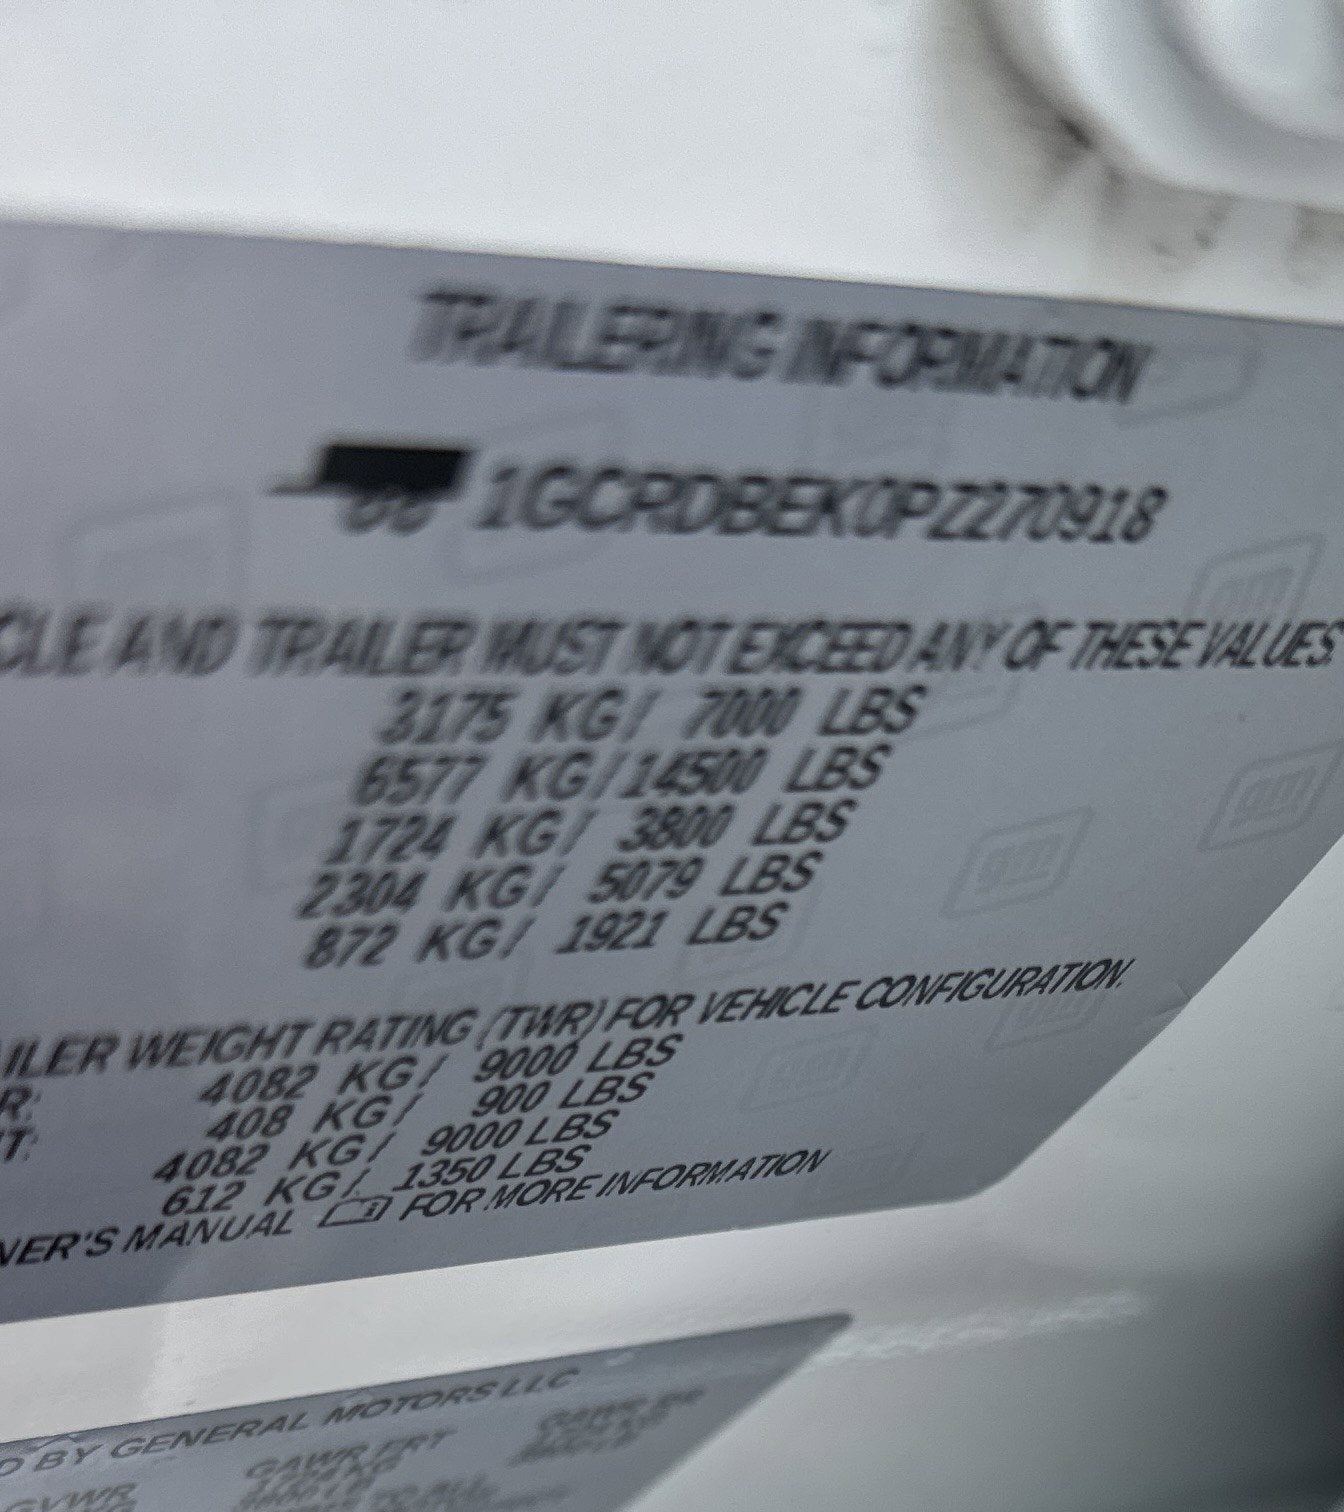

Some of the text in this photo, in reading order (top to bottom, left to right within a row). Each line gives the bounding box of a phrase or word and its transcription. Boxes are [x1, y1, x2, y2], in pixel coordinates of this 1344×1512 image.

[411, 290, 1150, 404] TRAILERING INFORMATION
[98, 612, 246, 676] AND
[254, 614, 472, 678] TRAILER
[476, 617, 630, 676] MUST
[628, 617, 734, 676] NOT
[728, 617, 912, 676] EXCEED
[908, 619, 1010, 674] ANY
[998, 618, 1076, 670] OF
[1068, 618, 1208, 670] THESE
[376, 688, 518, 744] 3175
[682, 684, 806, 740] 7000
[816, 682, 928, 738] LBS
[352, 752, 490, 804] 6577
[780, 740, 896, 796] LBS
[320, 814, 458, 868] 1724
[614, 801, 738, 854] 3800
[748, 797, 858, 850] LBS
[298, 868, 428, 922] 2304
[586, 856, 706, 906] 5079
[716, 850, 826, 900] LBS
[302, 920, 400, 970] 872
[554, 908, 672, 956] 1921
[684, 900, 790, 946] LBS
[122, 1018, 320, 1072] WEIGHT
[312, 1006, 482, 1058] RATING
[476, 998, 606, 1054] (TWR)
[598, 992, 698, 1036] FOR
[692, 980, 860, 1028] VEHICLE
[856, 957, 1136, 1012] CONFIGURATION.
[194, 1064, 322, 1108] 4082
[472, 1040, 580, 1084] 9000
[586, 1032, 684, 1076] LBS
[202, 1104, 298, 1144] 408
[470, 1078, 556, 1120] 900
[558, 1071, 656, 1112] LBS
[150, 1142, 274, 1186] 4082
[420, 1116, 524, 1160] 9000
[524, 1108, 622, 1150] LBS
[160, 1182, 248, 1218] 612
[392, 1152, 500, 1194] 1350
[496, 1143, 594, 1182] LBS
[120, 1208, 298, 1254] MANUAL
[398, 1184, 492, 1222] FOR
[484, 1174, 604, 1212] MORE
[596, 1149, 834, 1197] INFORMATION
[33, 1444, 103, 1473] BY
[109, 1415, 310, 1459] GENERAL
[321, 1382, 498, 1427] MOTORS
[496, 1366, 582, 1396] LLC
